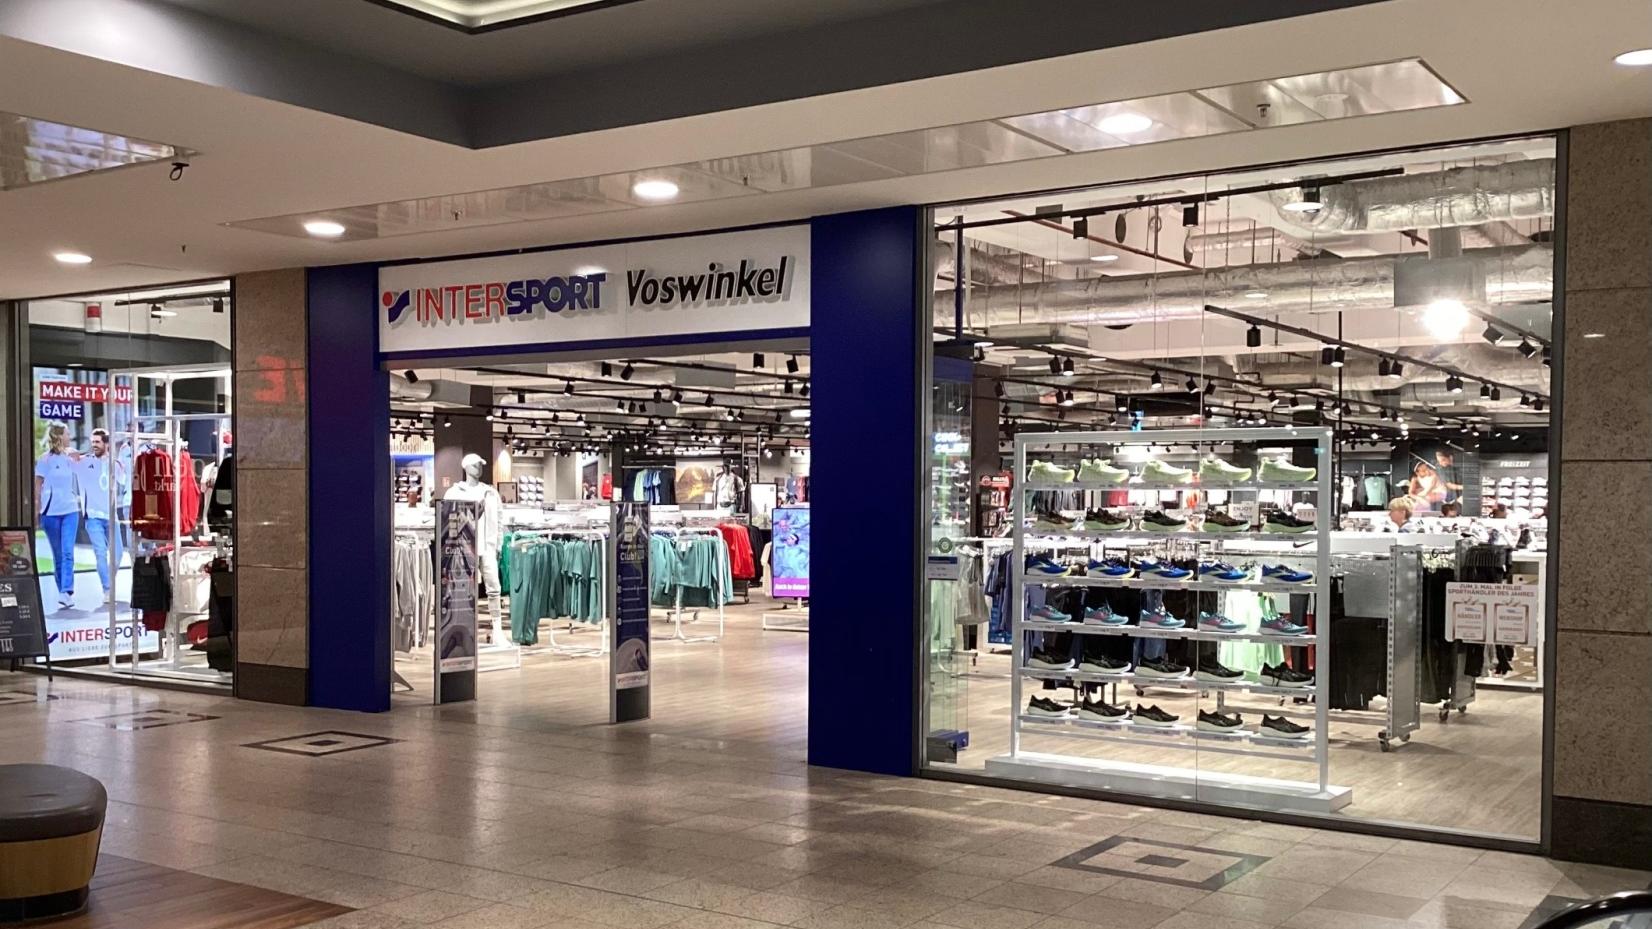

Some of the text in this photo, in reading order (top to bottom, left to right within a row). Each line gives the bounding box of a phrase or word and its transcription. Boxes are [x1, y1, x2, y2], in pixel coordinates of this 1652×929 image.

[415, 255, 788, 322] INTERSPORT Voswinkel
[42, 384, 82, 398] MAKE
[85, 387, 98, 399] IT
[42, 404, 81, 417] GAME
